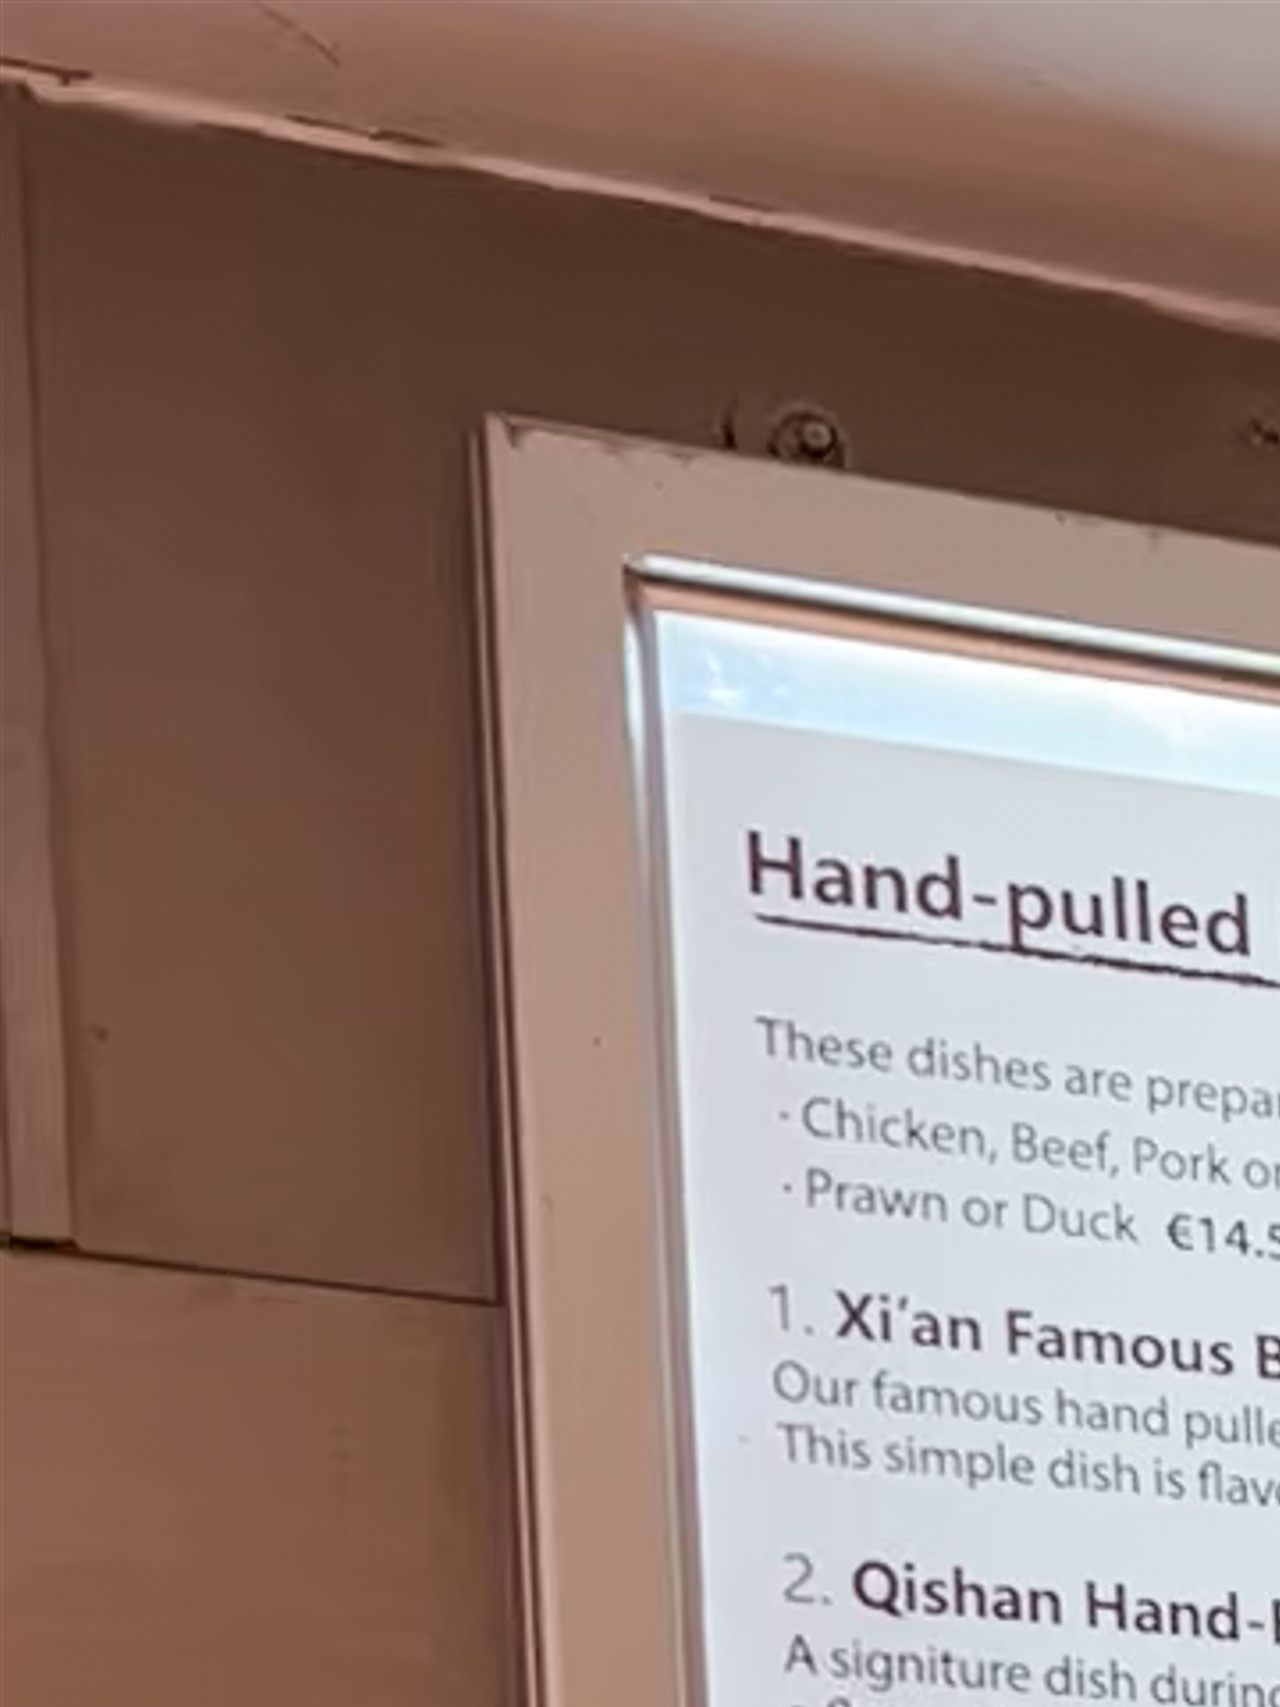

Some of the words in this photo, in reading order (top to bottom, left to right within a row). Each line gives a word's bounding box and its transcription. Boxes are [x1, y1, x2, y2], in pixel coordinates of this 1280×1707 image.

[747, 829, 1251, 957] Hand-pulled
[754, 1015, 892, 1072] These
[906, 1036, 1051, 1091] dishes
[1064, 1064, 1132, 1101] are
[801, 1096, 997, 1164] Chicken,
[1011, 1121, 1118, 1178] Beef,
[1132, 1136, 1231, 1185] Pork
[806, 1166, 947, 1221] Prawn
[961, 1196, 1008, 1228] or
[1022, 1192, 1137, 1243] Duck
[769, 1283, 813, 1335] 1.
[1005, 1307, 1235, 1376] Famous
[783, 1552, 831, 1605] 2.
[851, 1558, 1062, 1626] Qishan
